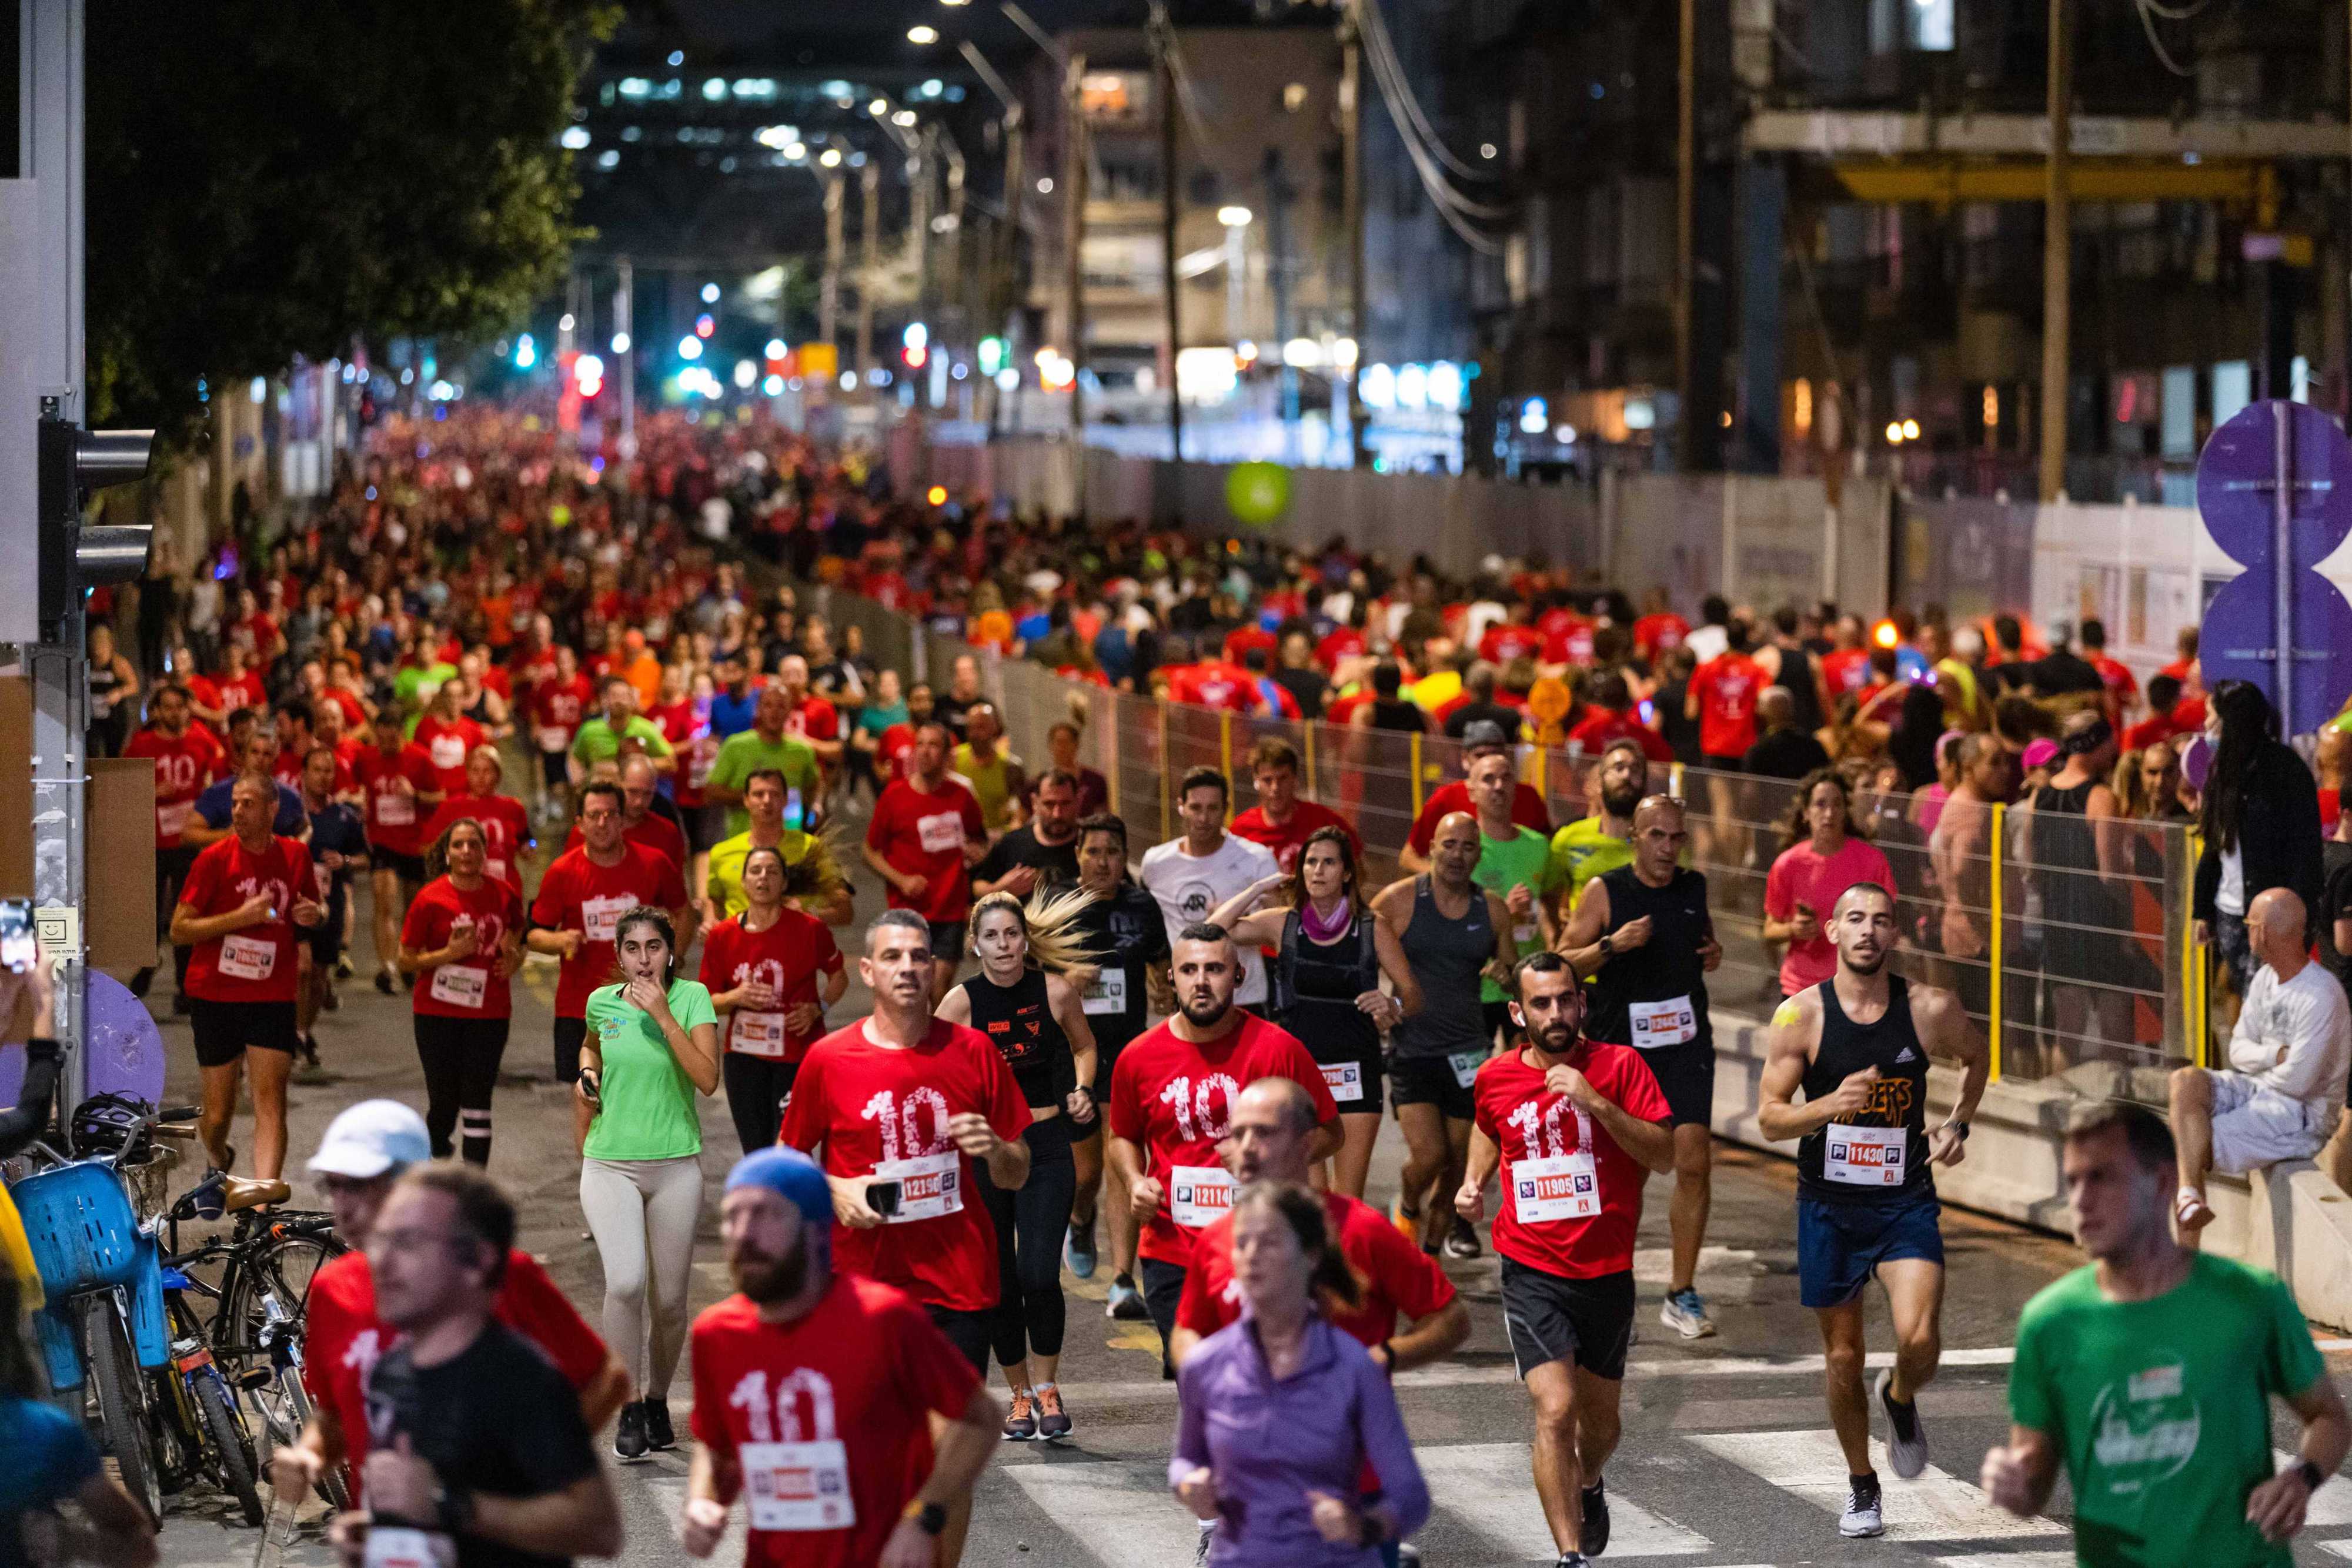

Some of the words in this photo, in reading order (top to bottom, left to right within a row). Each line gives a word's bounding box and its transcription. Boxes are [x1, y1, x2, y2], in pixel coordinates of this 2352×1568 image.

[156, 754, 196, 790] 10
[860, 1086, 949, 1162] 10
[1160, 1072, 1240, 1142] 10
[1506, 1095, 1593, 1159] 10
[1850, 1146, 1883, 1162] 11430
[1538, 1177, 1573, 1196] 11905
[729, 1366, 836, 1443] 10
